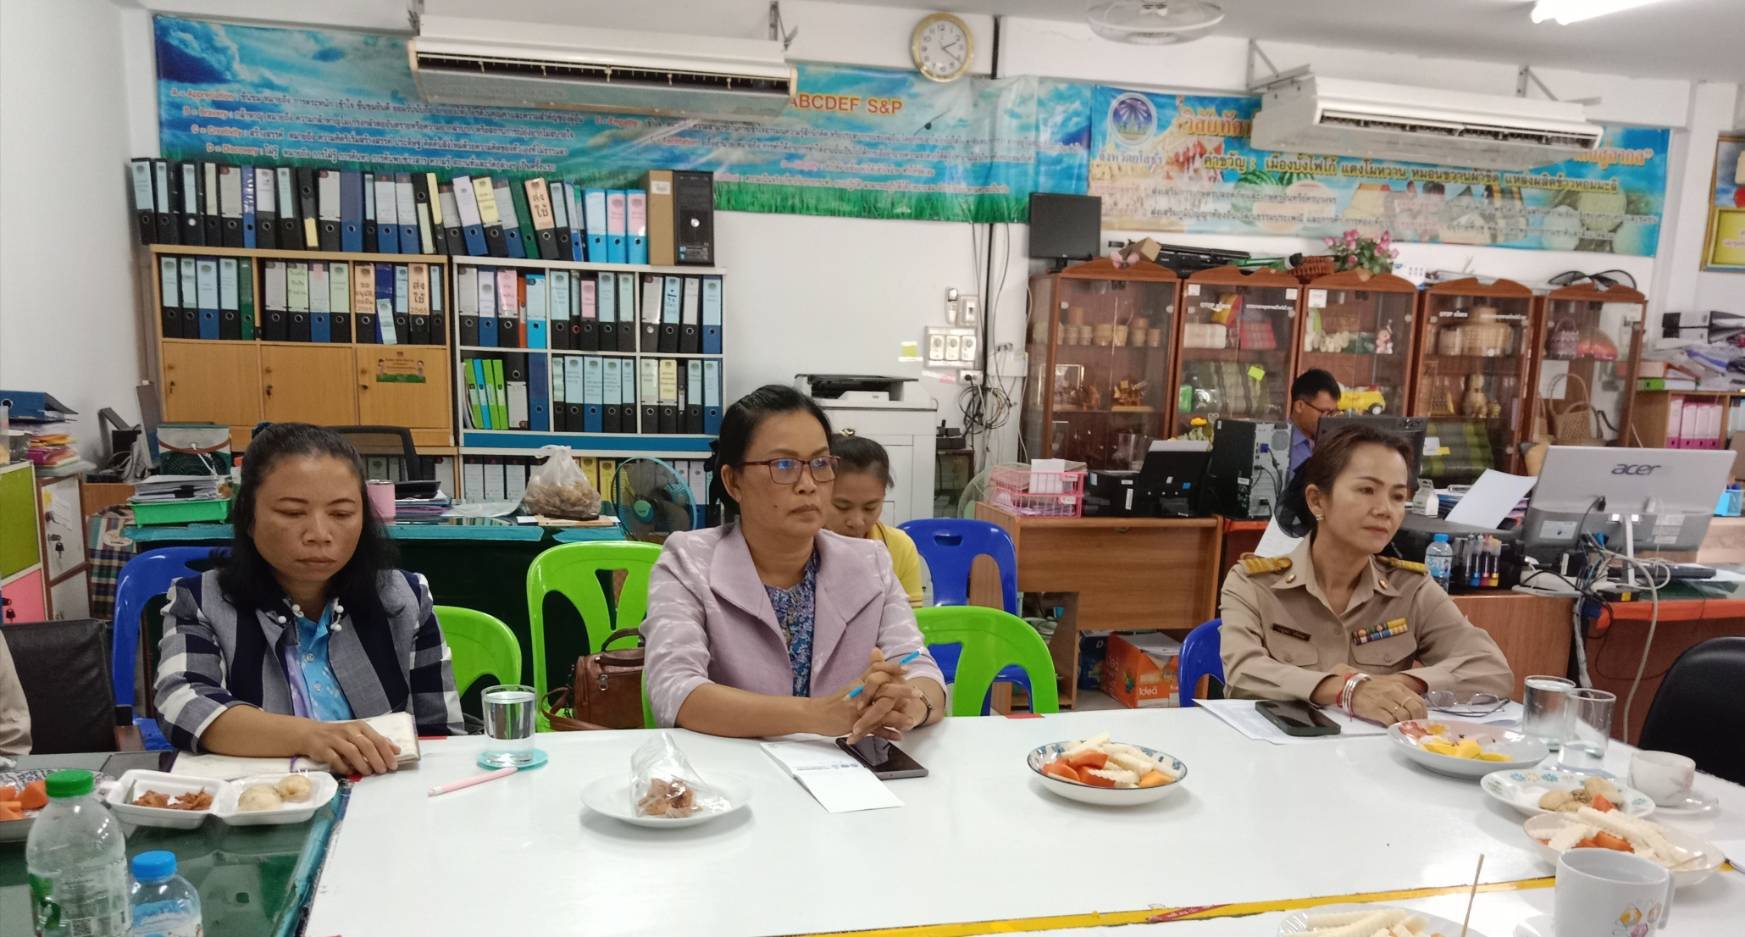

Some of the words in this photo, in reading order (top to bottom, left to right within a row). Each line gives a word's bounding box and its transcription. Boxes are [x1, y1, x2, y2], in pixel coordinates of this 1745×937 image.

[790, 93, 860, 112] ABCDEF
[866, 97, 903, 115] S&P
[1611, 463, 1662, 476] acer
